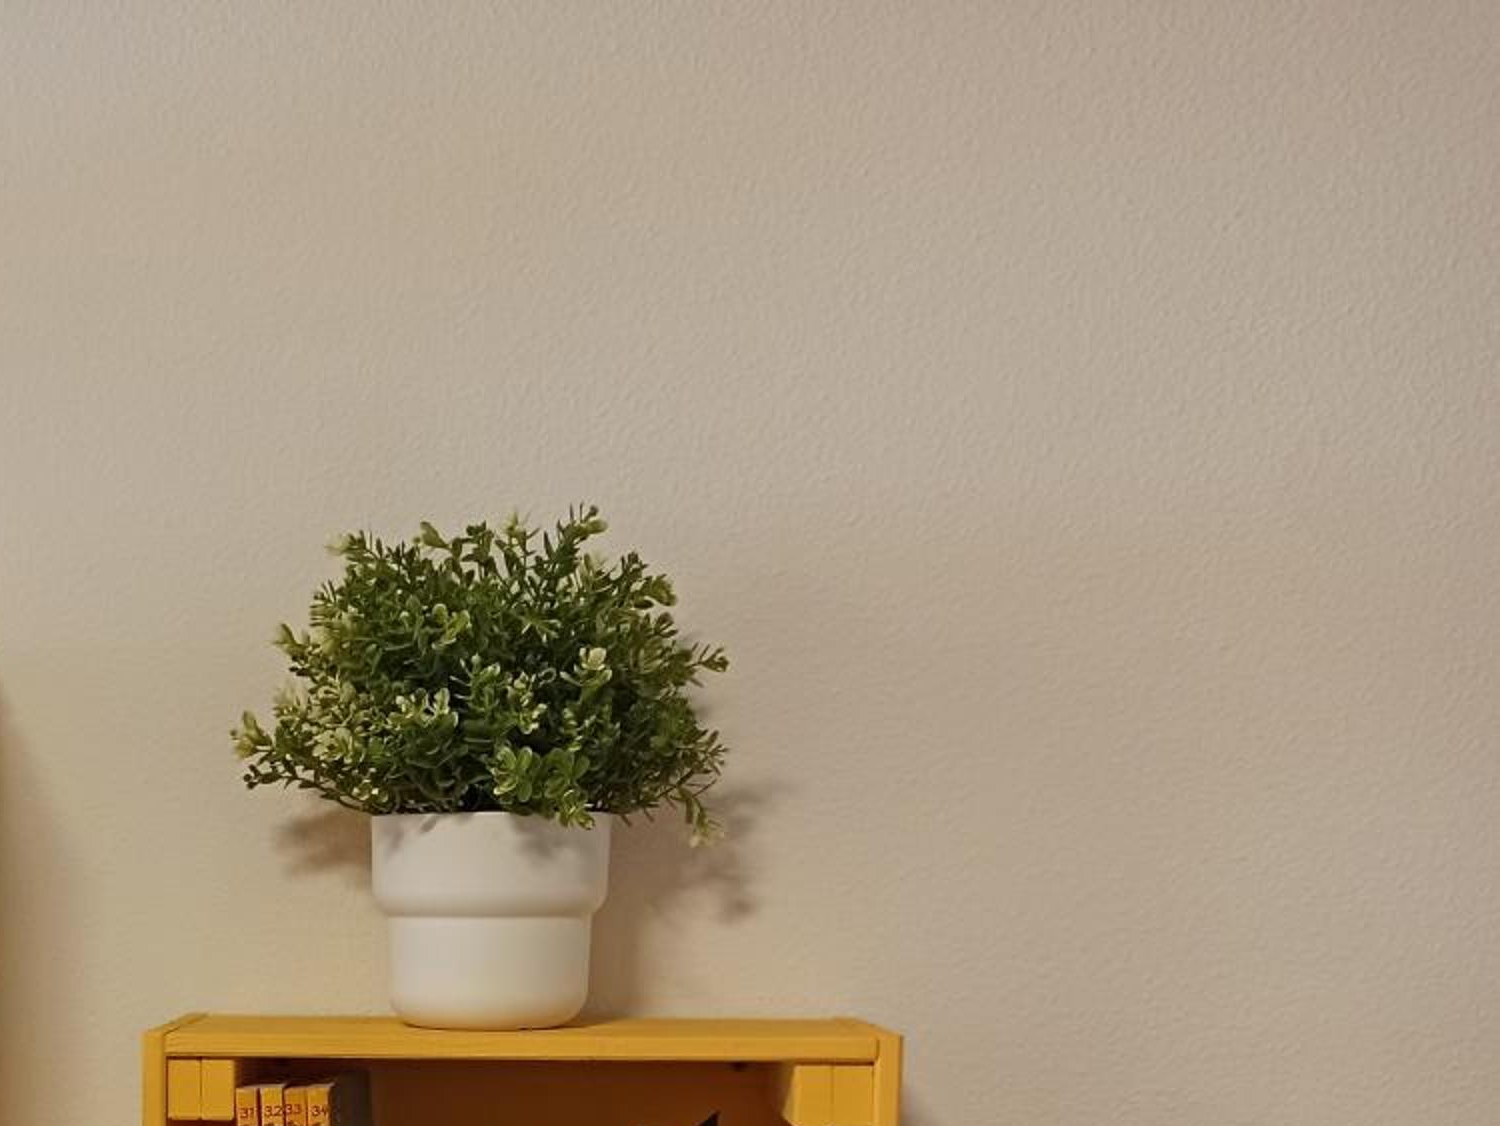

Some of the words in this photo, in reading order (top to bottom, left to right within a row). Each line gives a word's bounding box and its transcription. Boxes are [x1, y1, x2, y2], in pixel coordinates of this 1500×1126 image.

[238, 1107, 255, 1119] 31
[264, 1105, 283, 1117] 32
[311, 1104, 328, 1117] 34
